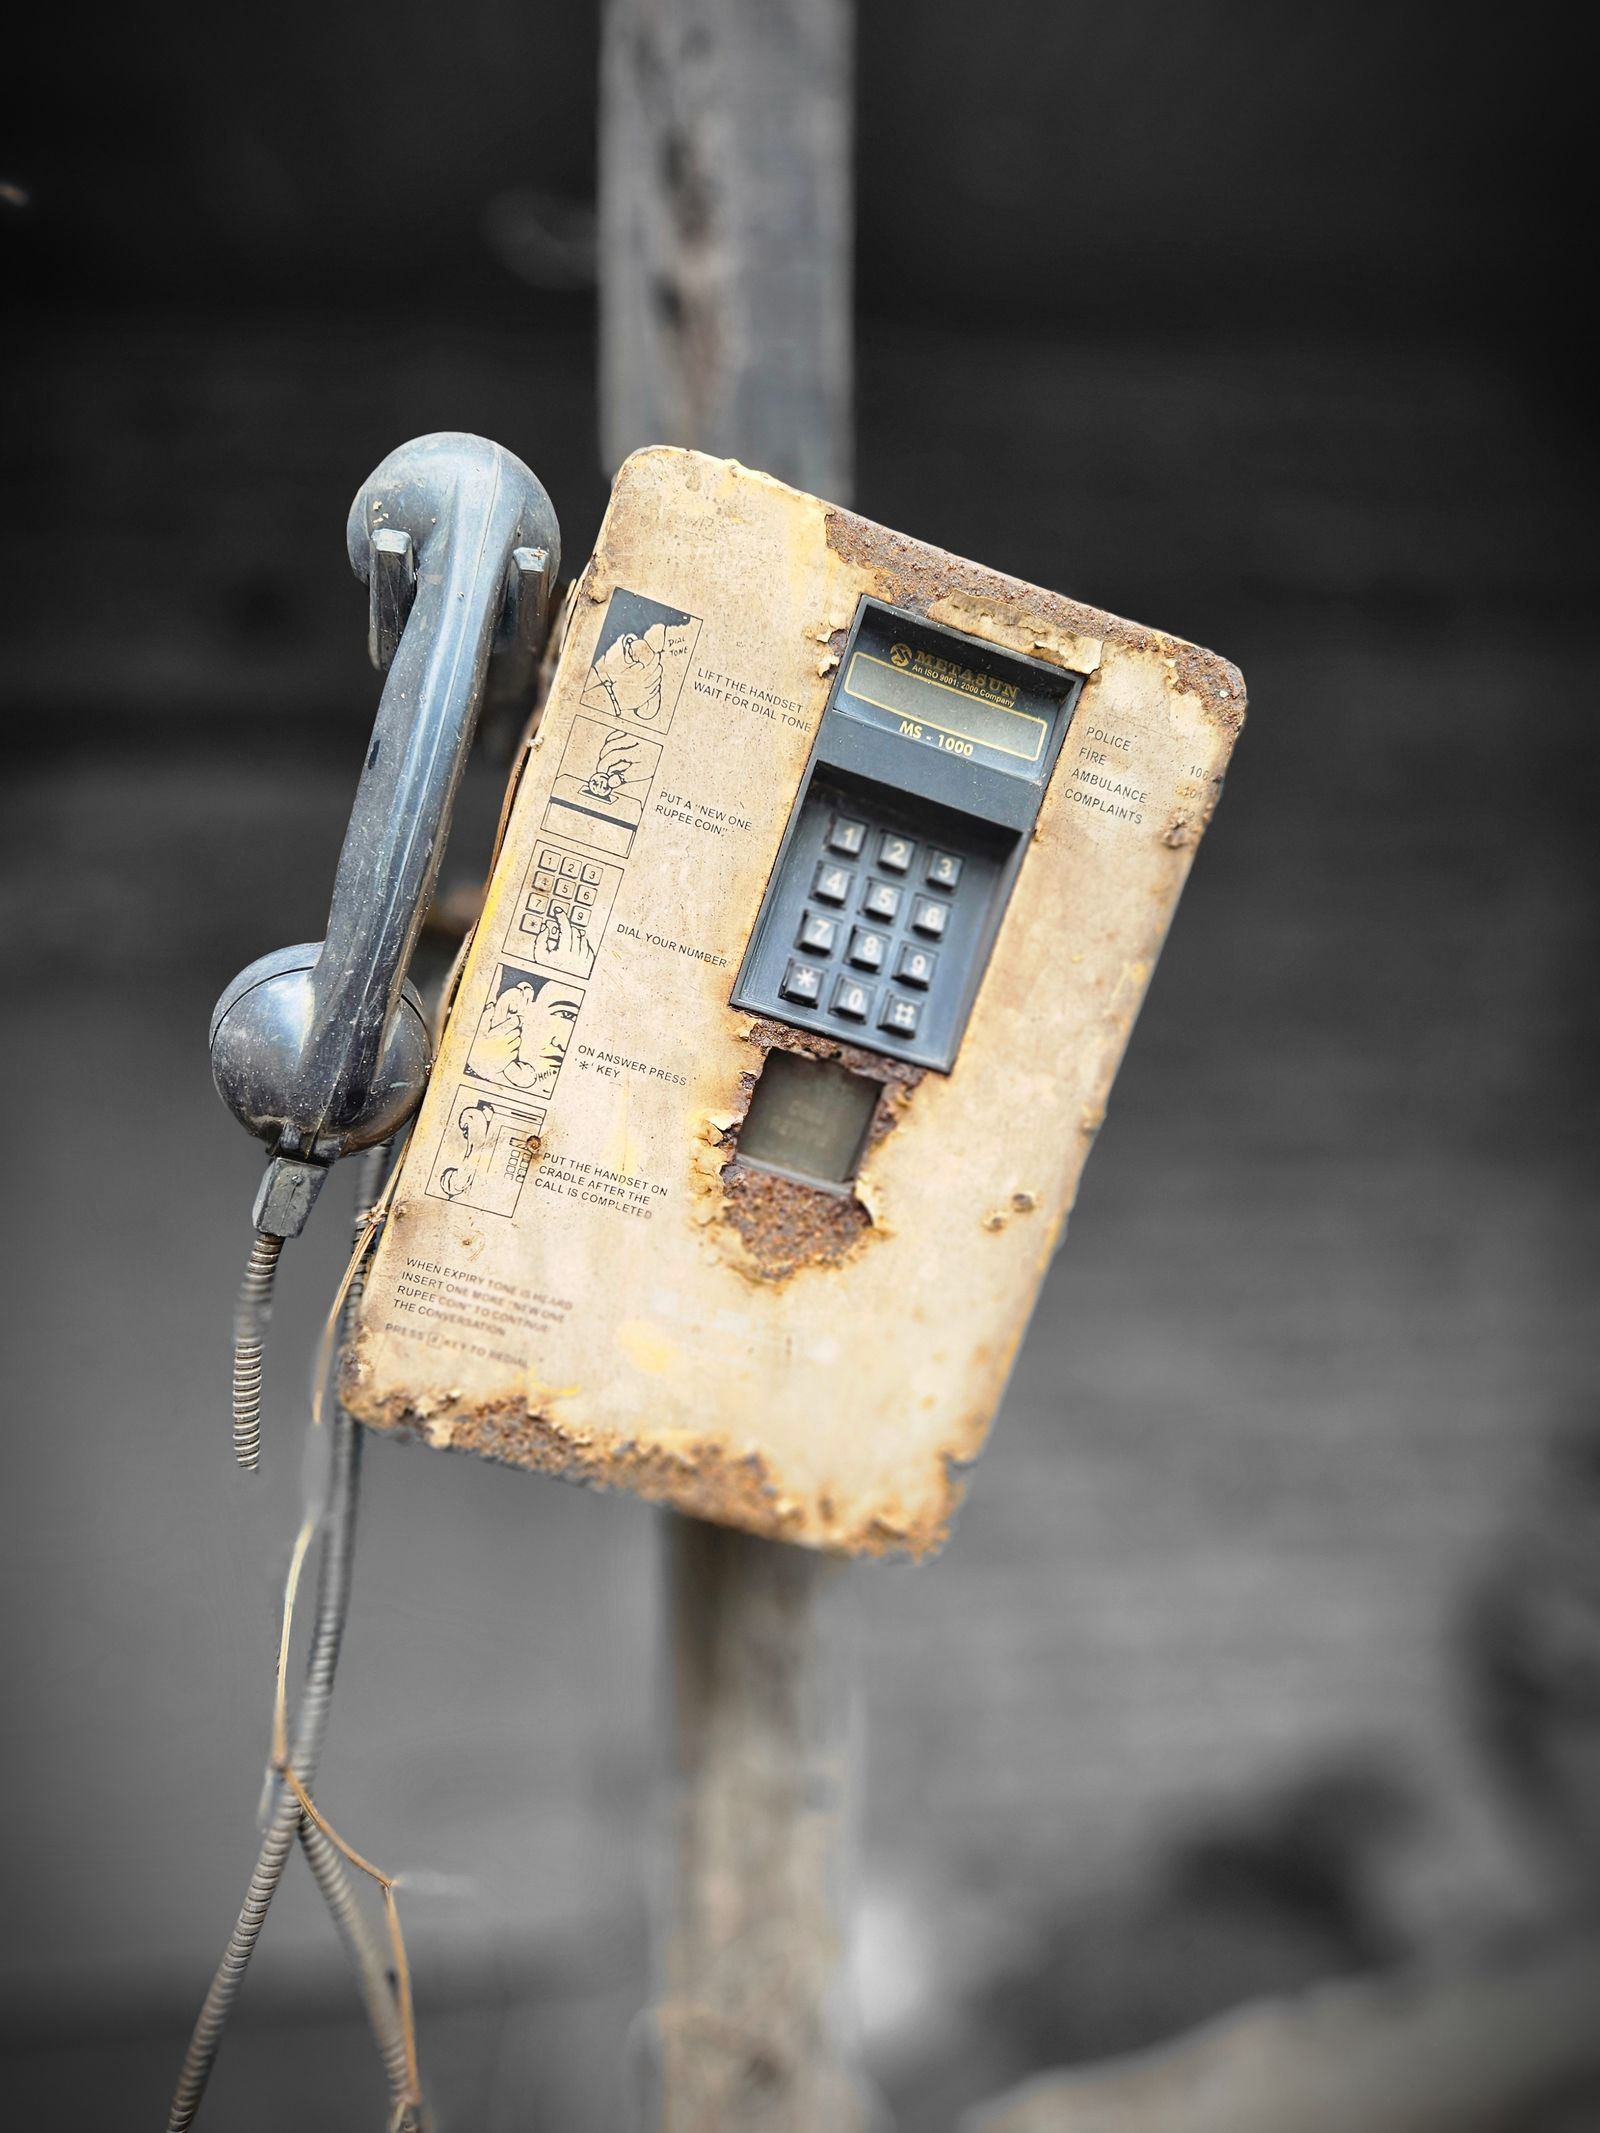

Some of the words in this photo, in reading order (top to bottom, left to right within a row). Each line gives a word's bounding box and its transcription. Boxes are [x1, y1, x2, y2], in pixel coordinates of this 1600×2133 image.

[697, 667, 723, 683] LIFT
[725, 677, 747, 693] THE
[749, 686, 803, 714] HANDSET
[912, 665, 923, 675] An
[924, 669, 939, 679] ISO
[960, 681, 979, 694] 2000
[979, 688, 1015, 708] Company
[694, 681, 722, 699] WAIT
[724, 692, 749, 709] FOR
[751, 703, 777, 721] DIAL
[781, 714, 812, 733] TONE
[899, 720, 923, 739] MS
[938, 734, 974, 757] 1000
[1079, 747, 1107, 765] FIRE
[1086, 726, 1131, 751] POLICE
[1071, 768, 1148, 803] AMBULANCE
[655, 804, 693, 825] RUPEE
[660, 791, 683, 805] PUT
[684, 800, 692, 809] A
[728, 815, 752, 832] ONE
[1065, 788, 1143, 824] COMPLAINTS
[617, 923, 641, 939] DIAL
[645, 933, 677, 951] YOUR
[678, 945, 728, 968] NUMBER
[578, 1044, 595, 1056] ON
[597, 1051, 647, 1073] ANSWER
[649, 1067, 687, 1086] PRESS
[596, 1065, 621, 1079] KEY
[539, 1165, 586, 1186] CRADLE
[588, 1180, 625, 1197] AFTER
[628, 1191, 651, 1205] THE
[543, 1152, 567, 1165] PUT
[569, 1160, 592, 1174] THE
[594, 1168, 649, 1190] HANDSET
[651, 1185, 668, 1196] ON
[535, 1178, 564, 1194] CALL
[567, 1188, 579, 1198] IS
[581, 1191, 653, 1220] COMPLETED
[401, 1271, 444, 1290] INSERT
[446, 1283, 470, 1298] ONE
[407, 1258, 441, 1274] WHEN
[443, 1267, 485, 1285] EXPIRY
[397, 1285, 437, 1303] RUPEE
[393, 1298, 416, 1312] THE
[418, 1306, 506, 1337] CONVERSATION
